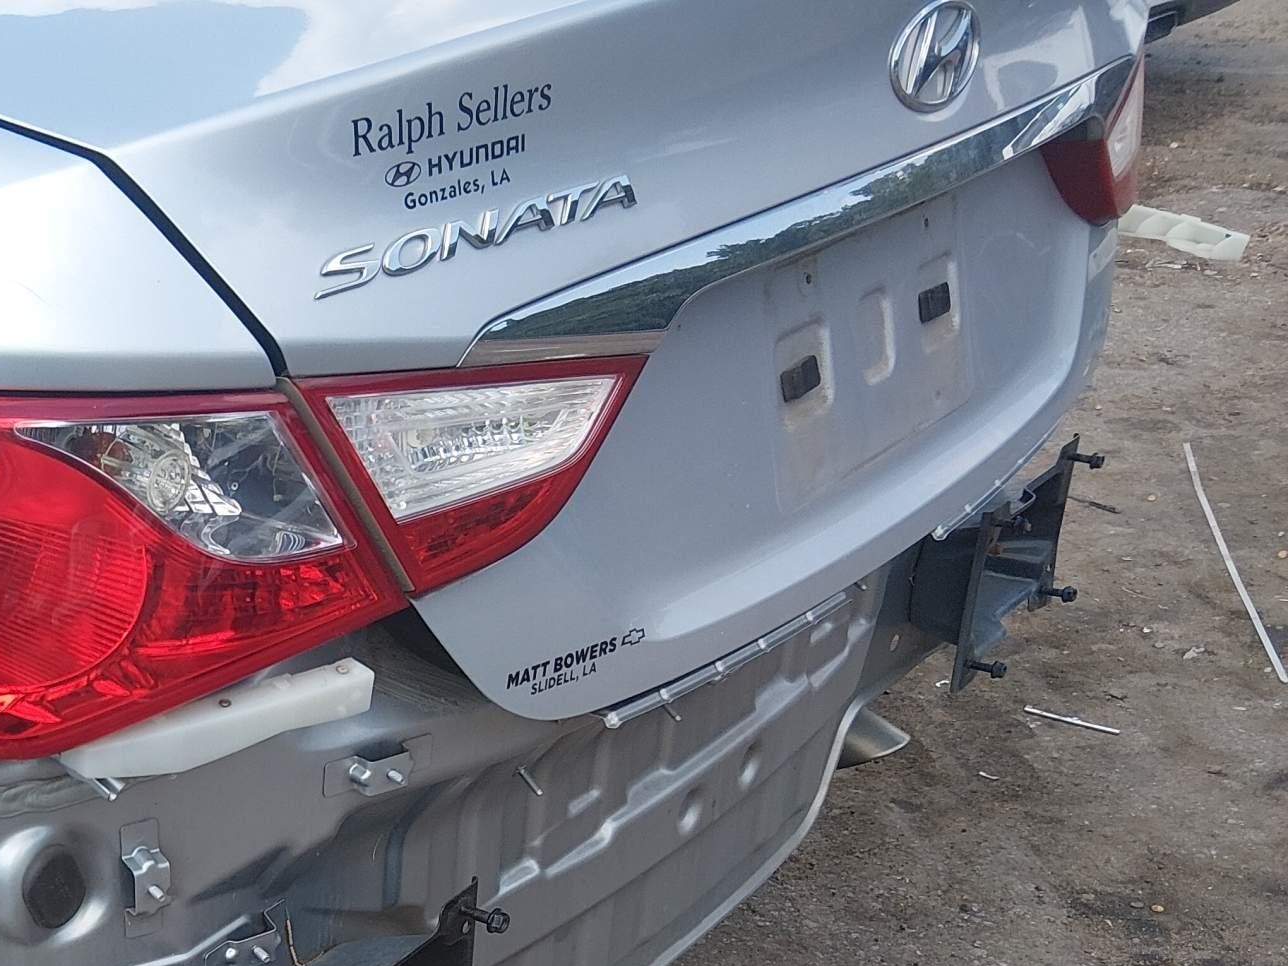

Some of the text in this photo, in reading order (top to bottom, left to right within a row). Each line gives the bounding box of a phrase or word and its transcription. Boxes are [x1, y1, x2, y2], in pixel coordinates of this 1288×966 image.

[351, 82, 552, 157] Ralph Sellers
[428, 134, 526, 177] HYUNDAI
[404, 168, 511, 210] Gonzales, LA
[314, 175, 638, 300] SONATA
[506, 637, 617, 689] MATT BOWERS
[530, 662, 597, 695] SLIDELL, LA
